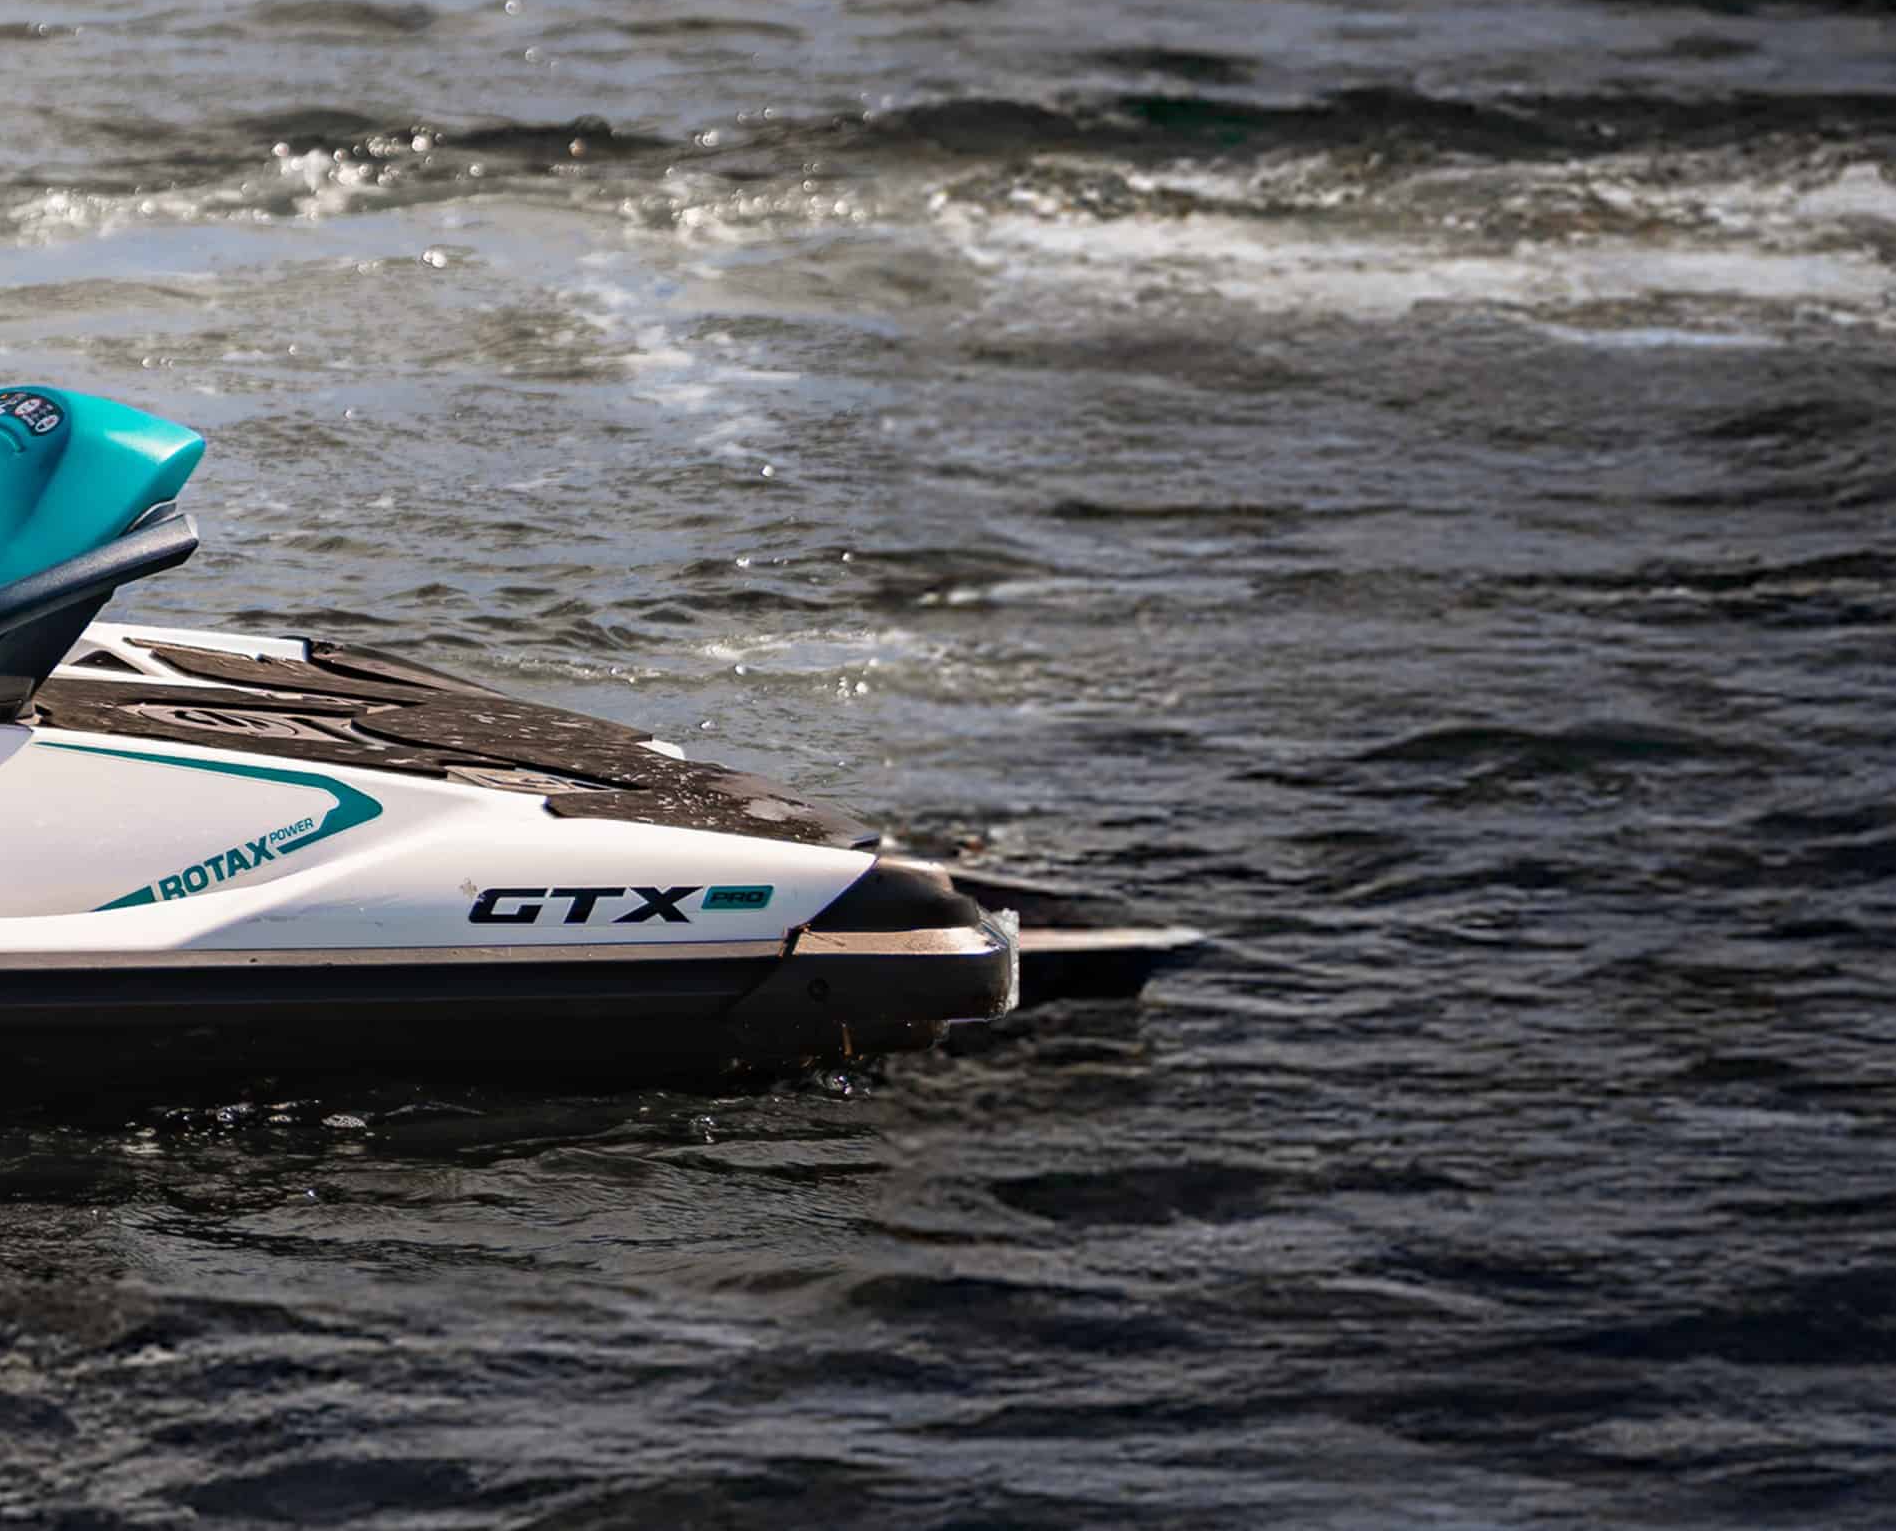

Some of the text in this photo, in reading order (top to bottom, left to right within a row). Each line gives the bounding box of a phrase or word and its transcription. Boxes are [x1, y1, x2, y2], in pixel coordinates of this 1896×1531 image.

[158, 817, 315, 901] ROTAX POWER
[468, 886, 765, 924] GTX PRO
